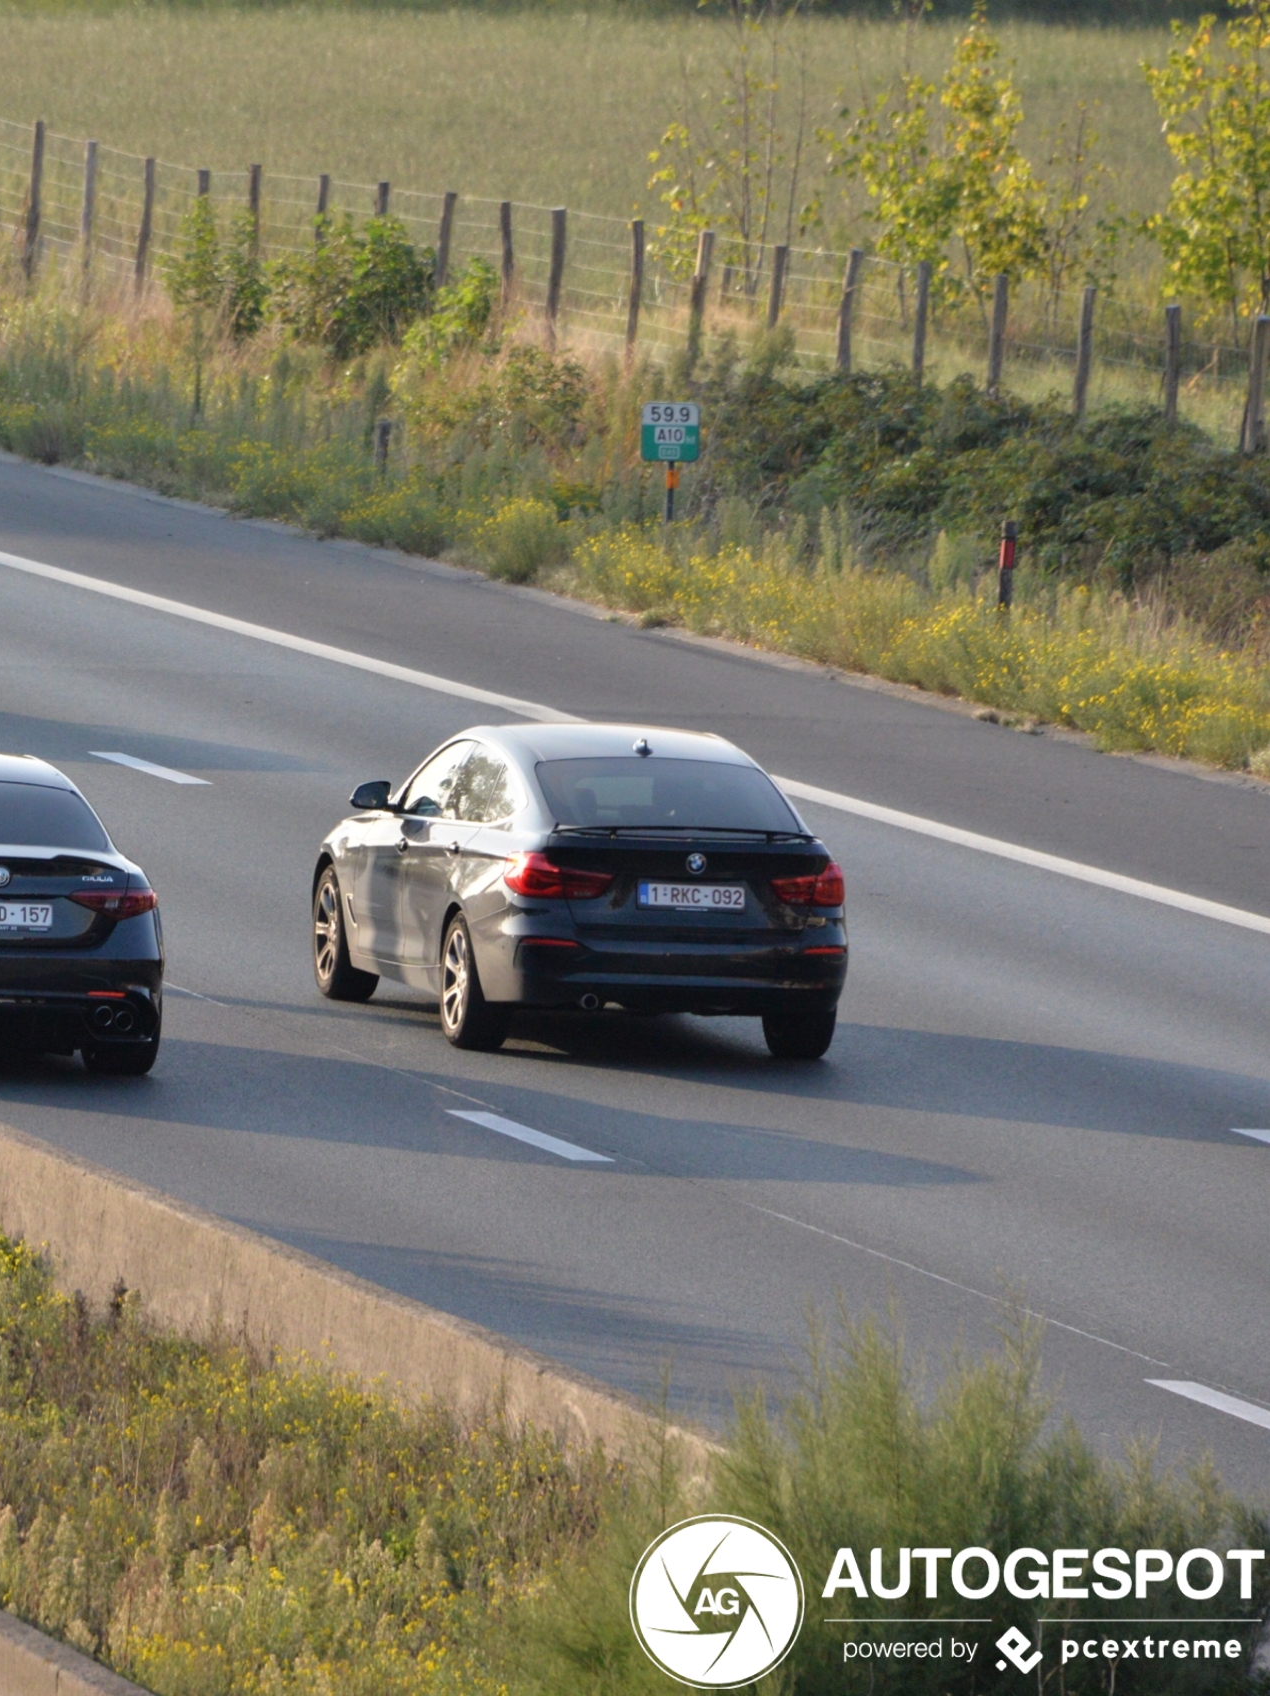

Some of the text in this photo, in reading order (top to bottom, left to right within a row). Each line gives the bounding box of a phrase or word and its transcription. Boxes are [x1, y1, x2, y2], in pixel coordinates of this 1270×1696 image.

[650, 406, 691, 423] 59.9
[657, 428, 683, 442] A10
[651, 886, 743, 906] 1-RKC-092
